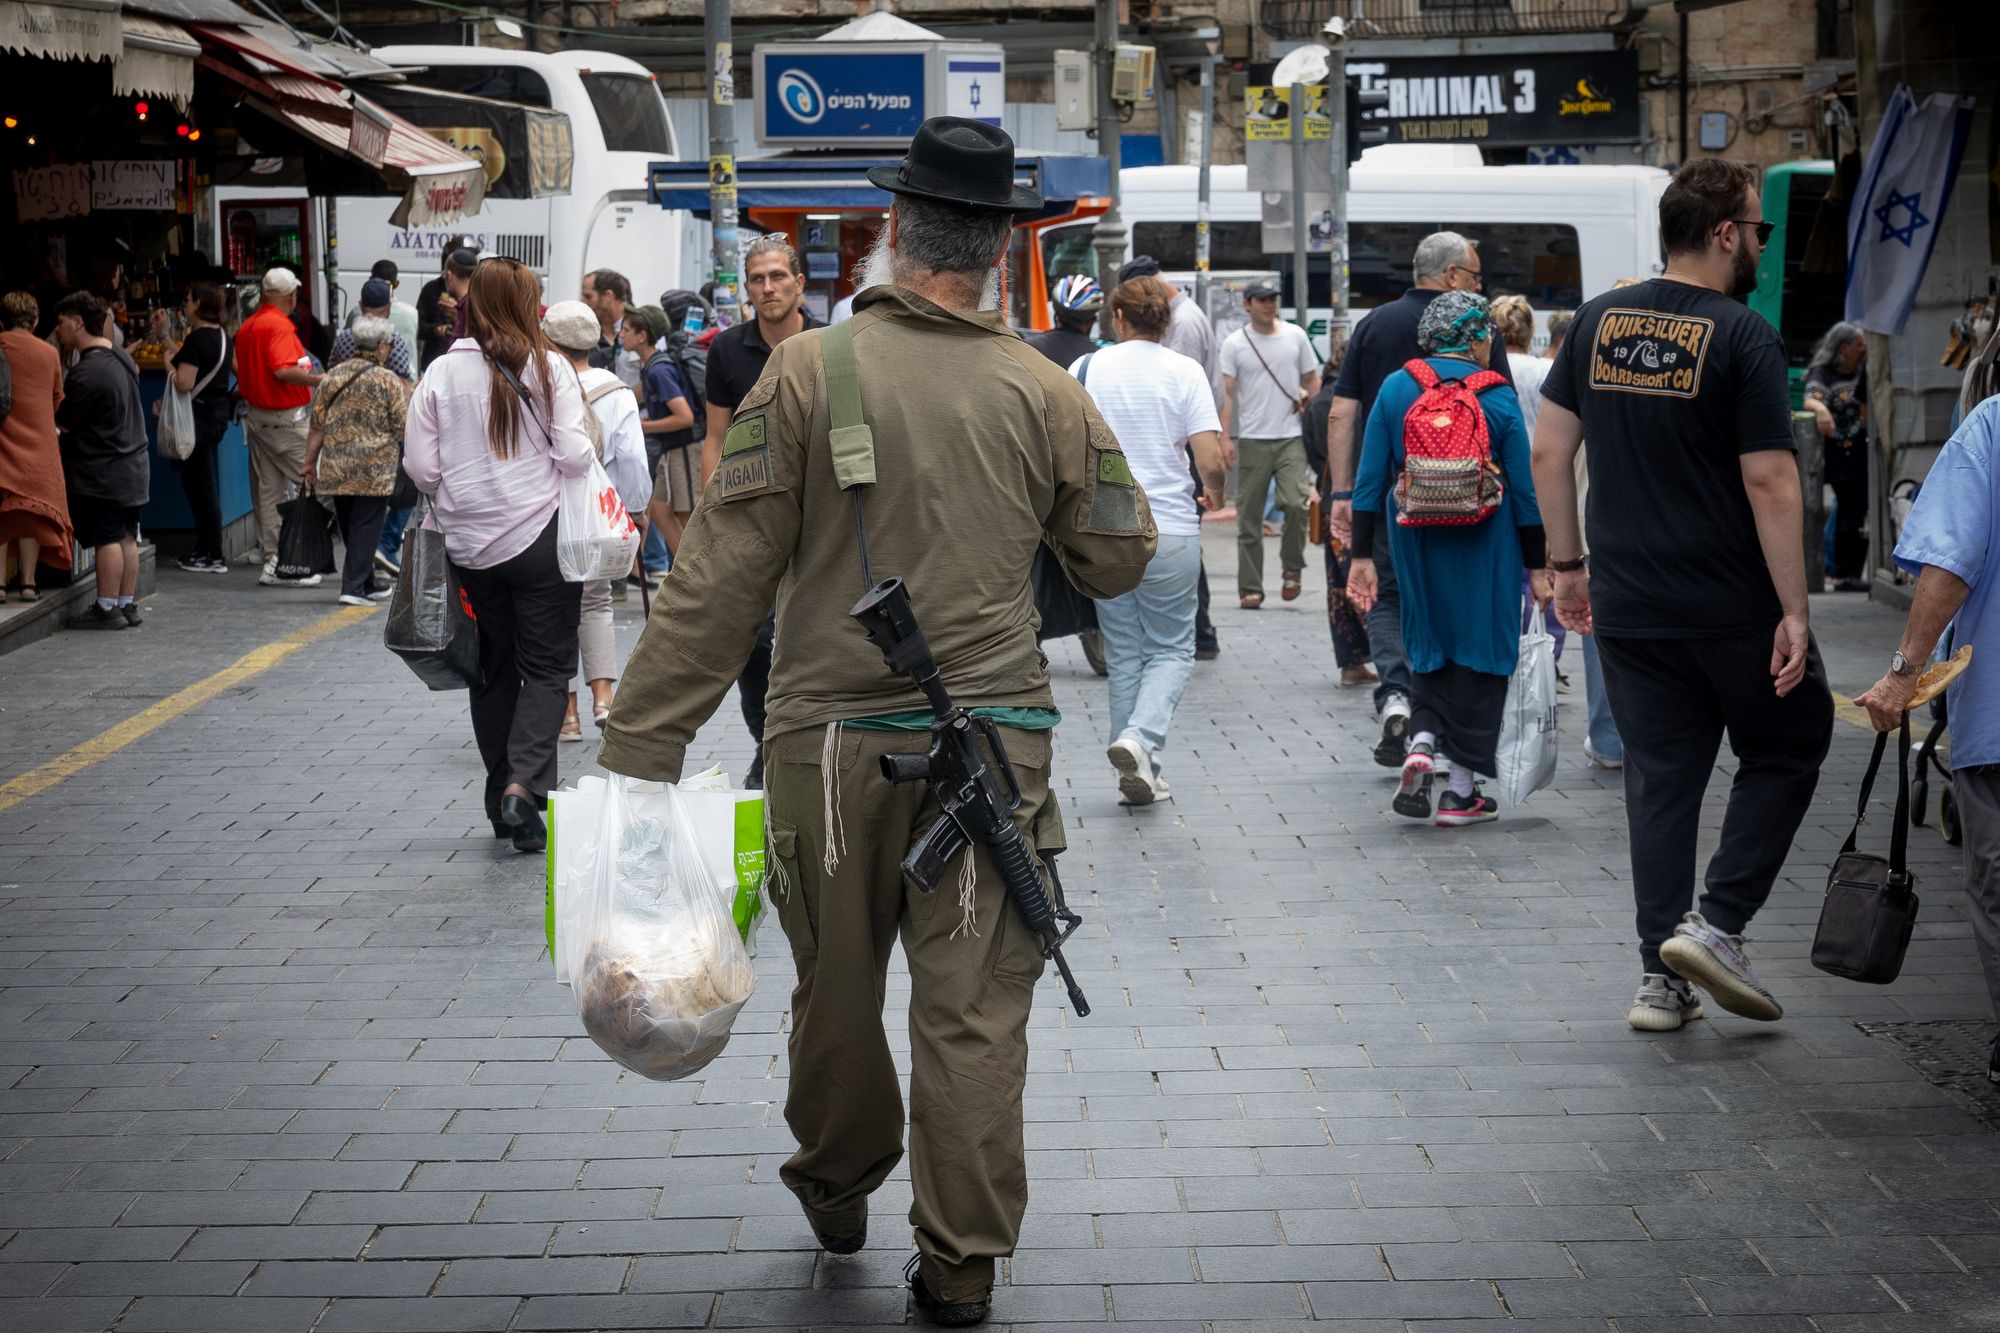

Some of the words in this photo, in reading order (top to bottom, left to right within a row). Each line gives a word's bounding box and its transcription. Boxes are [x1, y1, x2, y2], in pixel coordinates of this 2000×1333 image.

[828, 95, 866, 110] הפיס
[867, 93, 911, 110] מפעל
[1513, 69, 1536, 113] 3
[391, 232, 424, 249] AYA
[426, 232, 485, 249] TOS
[1600, 315, 1703, 357] QUIKSILVER
[1613, 347, 1628, 358] 19
[1662, 352, 1677, 363] 69
[1595, 354, 1671, 388] BOARDSHORT
[1673, 368, 1693, 390] CO
[725, 460, 765, 490] AGAM
